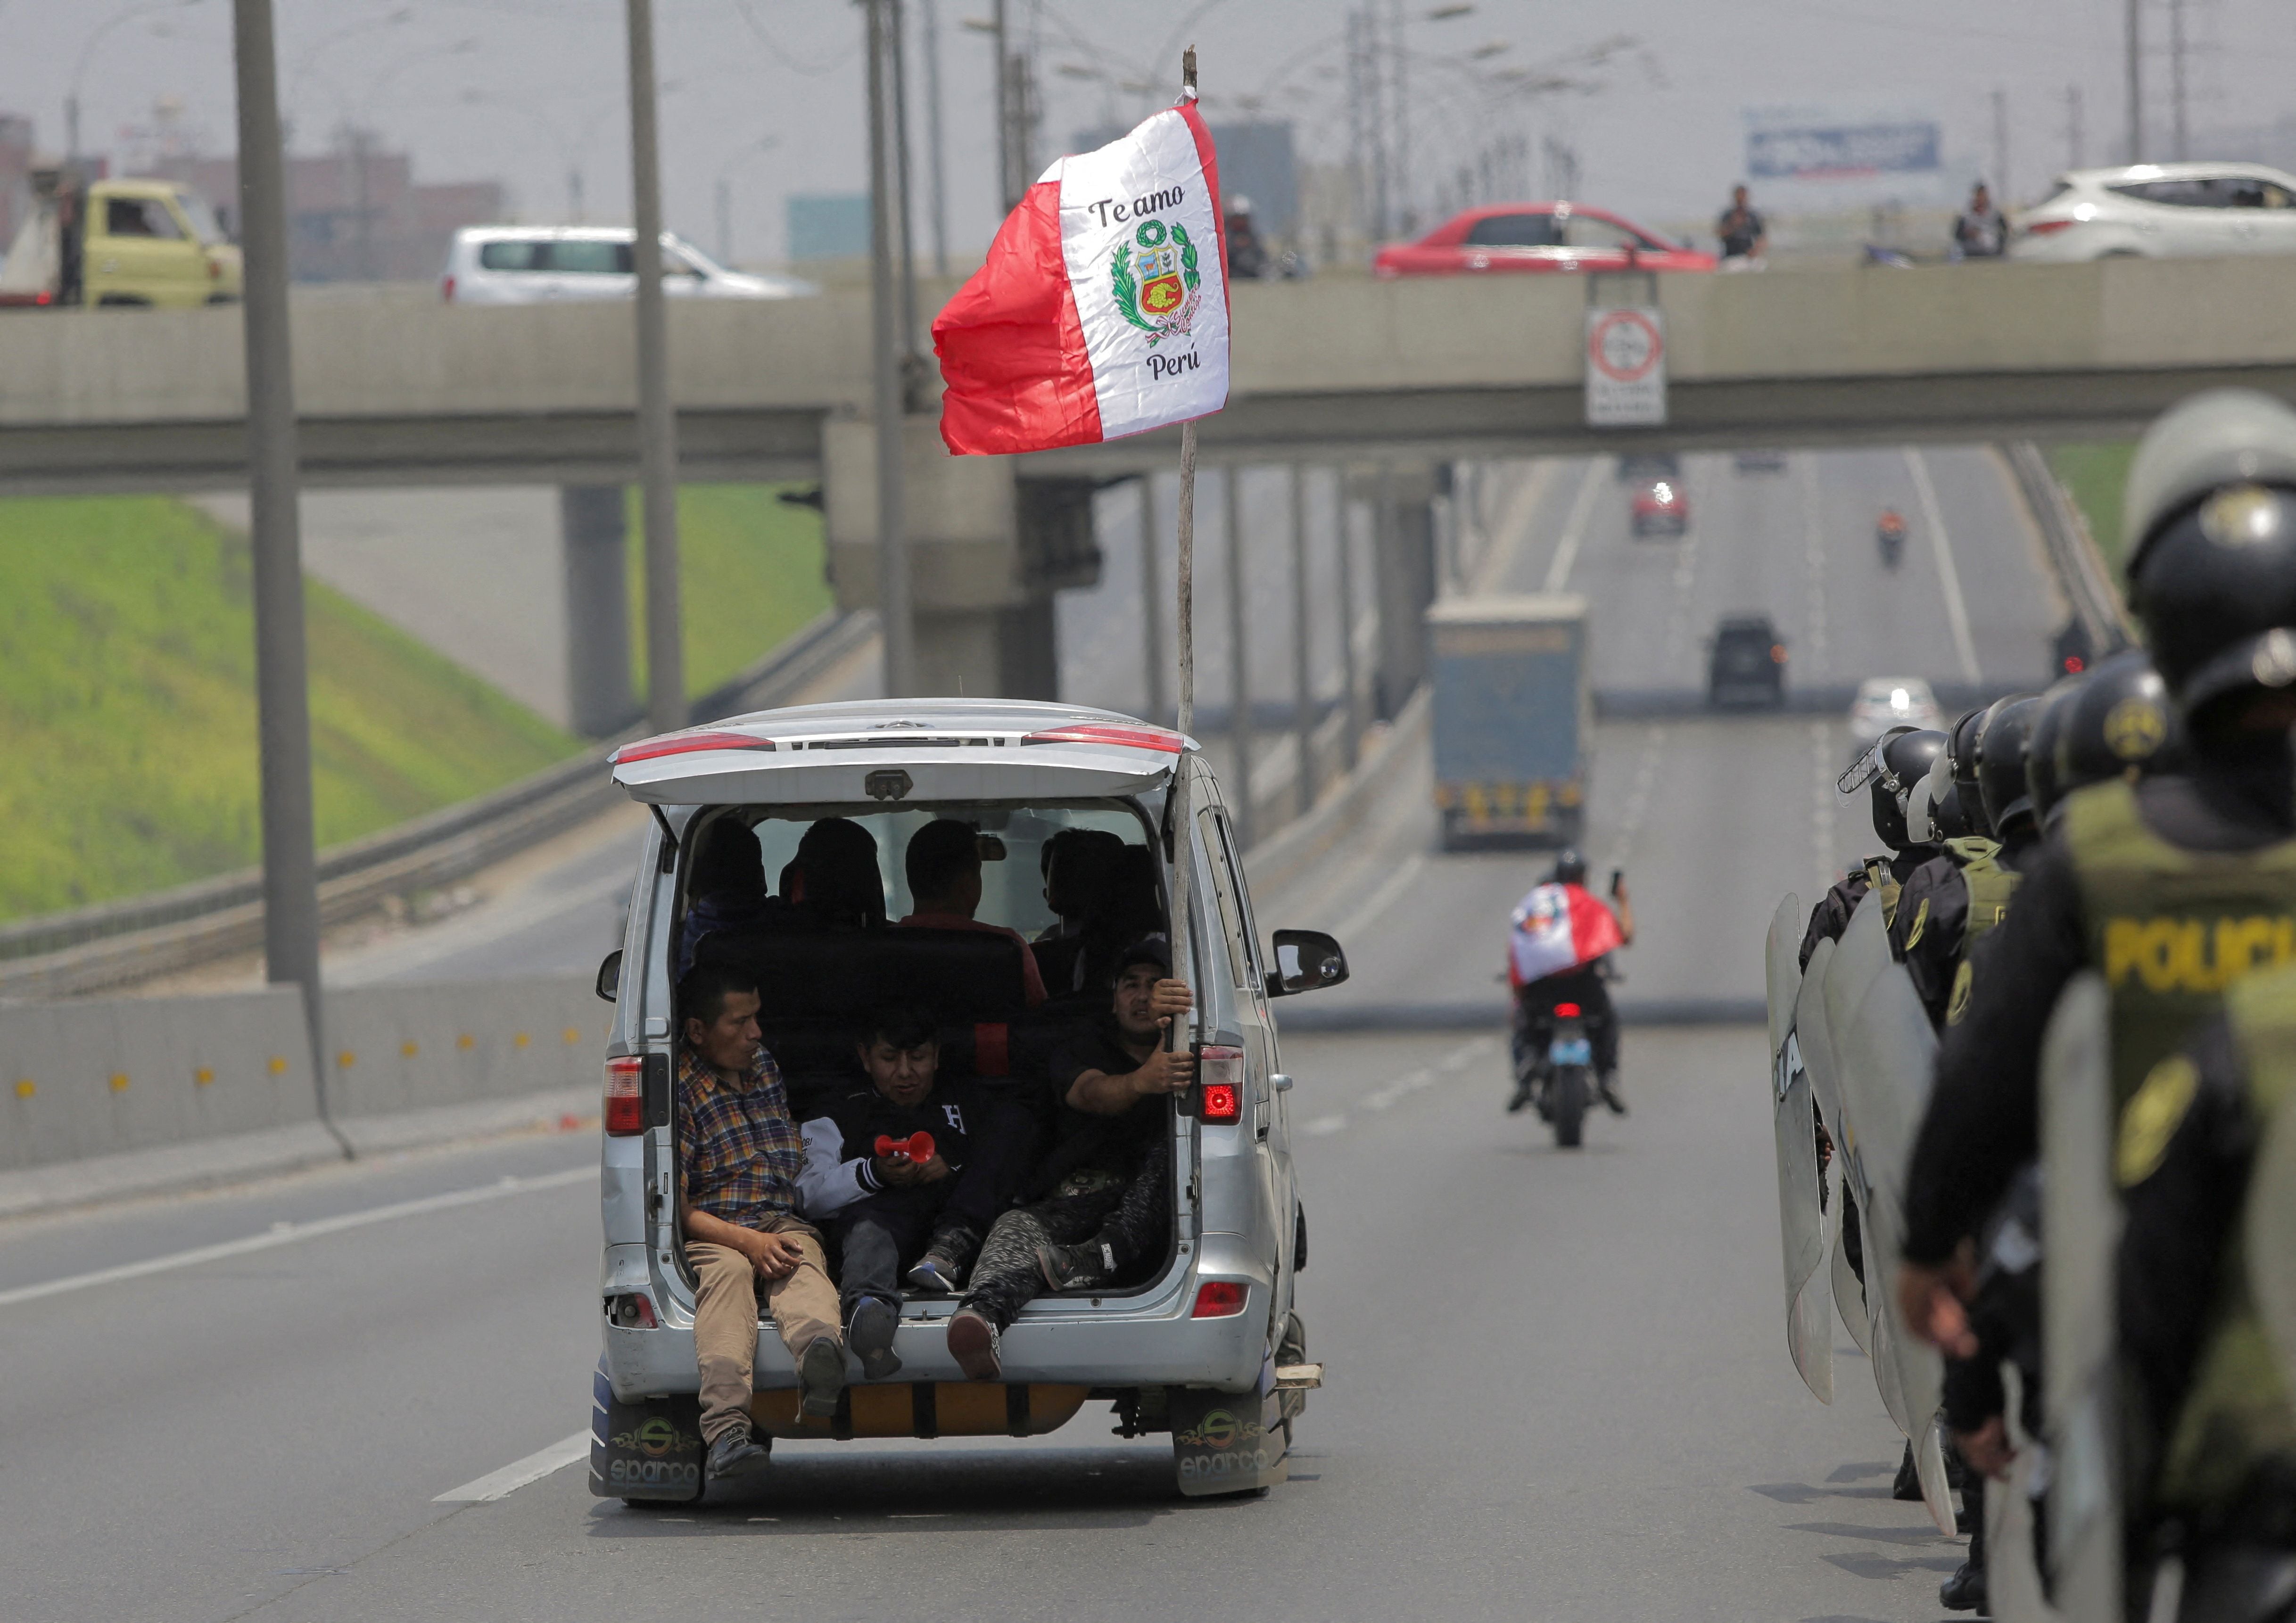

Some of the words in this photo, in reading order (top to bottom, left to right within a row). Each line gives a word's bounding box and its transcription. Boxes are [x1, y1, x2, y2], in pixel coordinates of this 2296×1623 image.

[1088, 198, 1130, 227] Te
[1133, 186, 1185, 217] amo
[1173, 283, 1198, 326] Siempre
[1181, 295, 1201, 333] Contigo
[1147, 342, 1200, 380] Perú
[2106, 915, 2296, 991] POLICI
[611, 1459, 699, 1489] sparco
